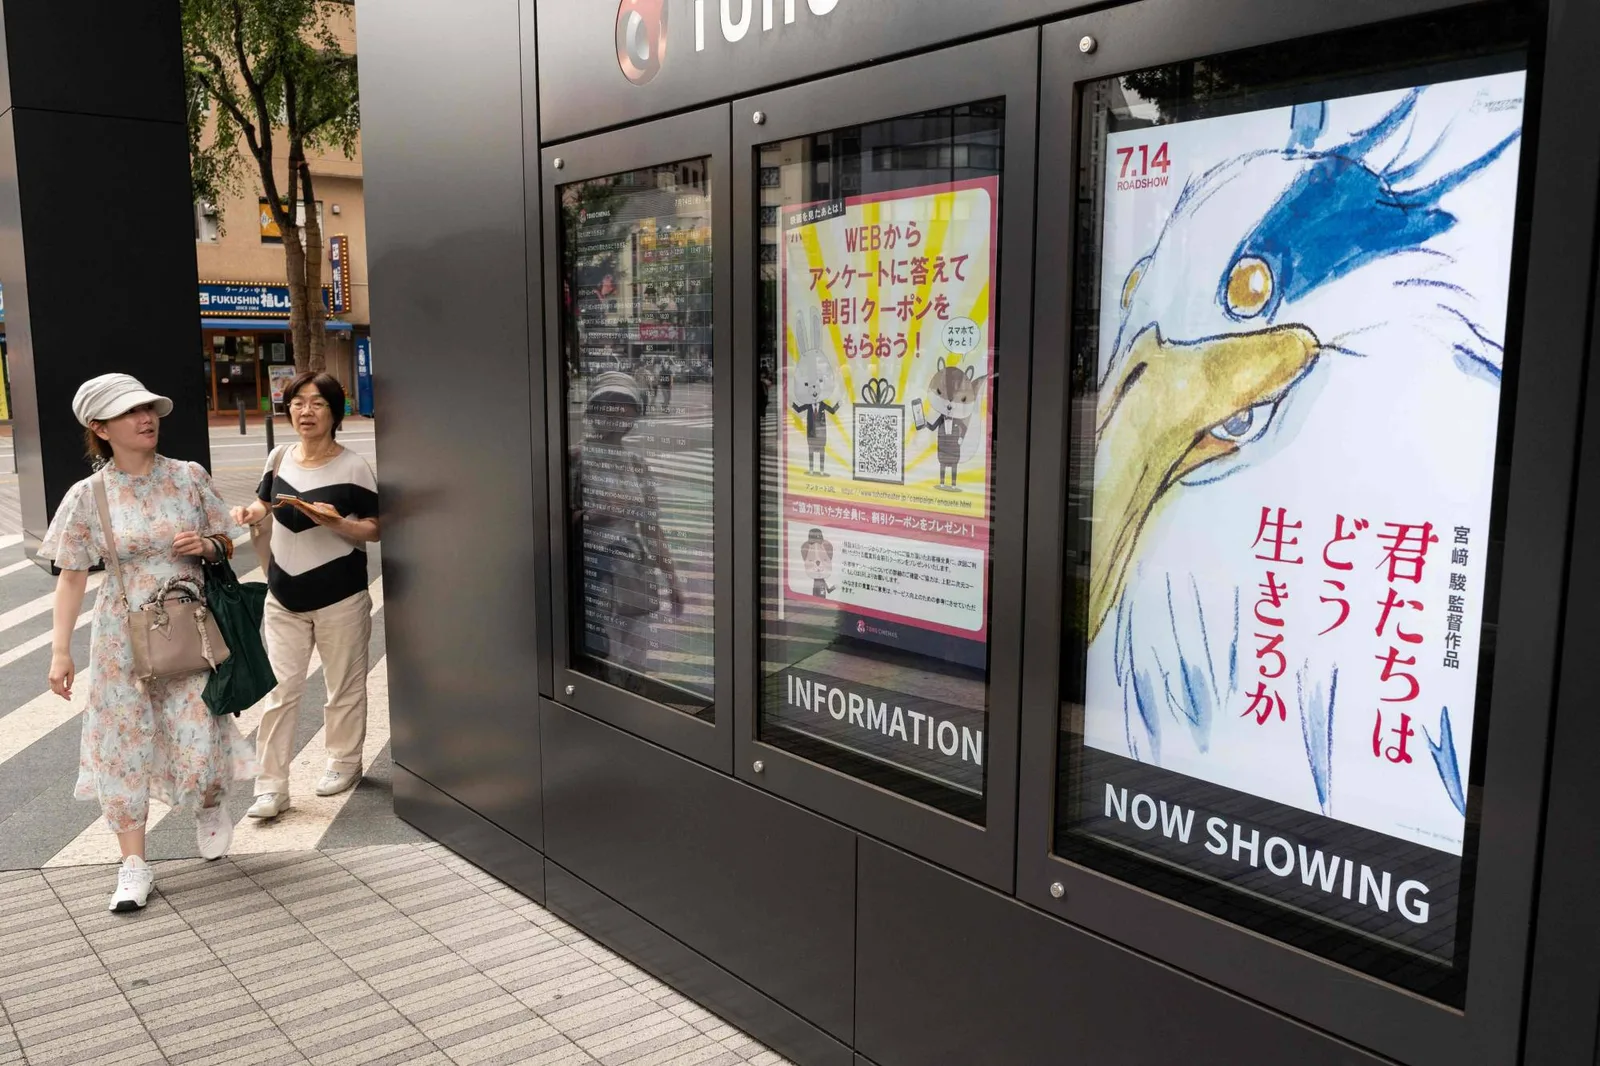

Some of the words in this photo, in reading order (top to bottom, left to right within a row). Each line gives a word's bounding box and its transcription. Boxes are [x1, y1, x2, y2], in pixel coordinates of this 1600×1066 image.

[1116, 142, 1171, 179] 7.14
[1116, 176, 1169, 192] ROADSHOW
[845, 221, 922, 253] WEBから
[809, 254, 969, 291] アンケートに答えて
[211, 295, 260, 305] FUKUSHIN
[821, 293, 950, 326] 割引クーポンを
[843, 332, 921, 359] もらおう！
[948, 325, 974, 335] スマホで
[1317, 513, 1369, 636] どう
[1239, 506, 1304, 726] 生きるか
[1372, 521, 1439, 764] 君たちは
[787, 674, 983, 766] INFORMATION
[1104, 783, 1195, 844] NOW
[1204, 816, 1430, 924] SHOWING
